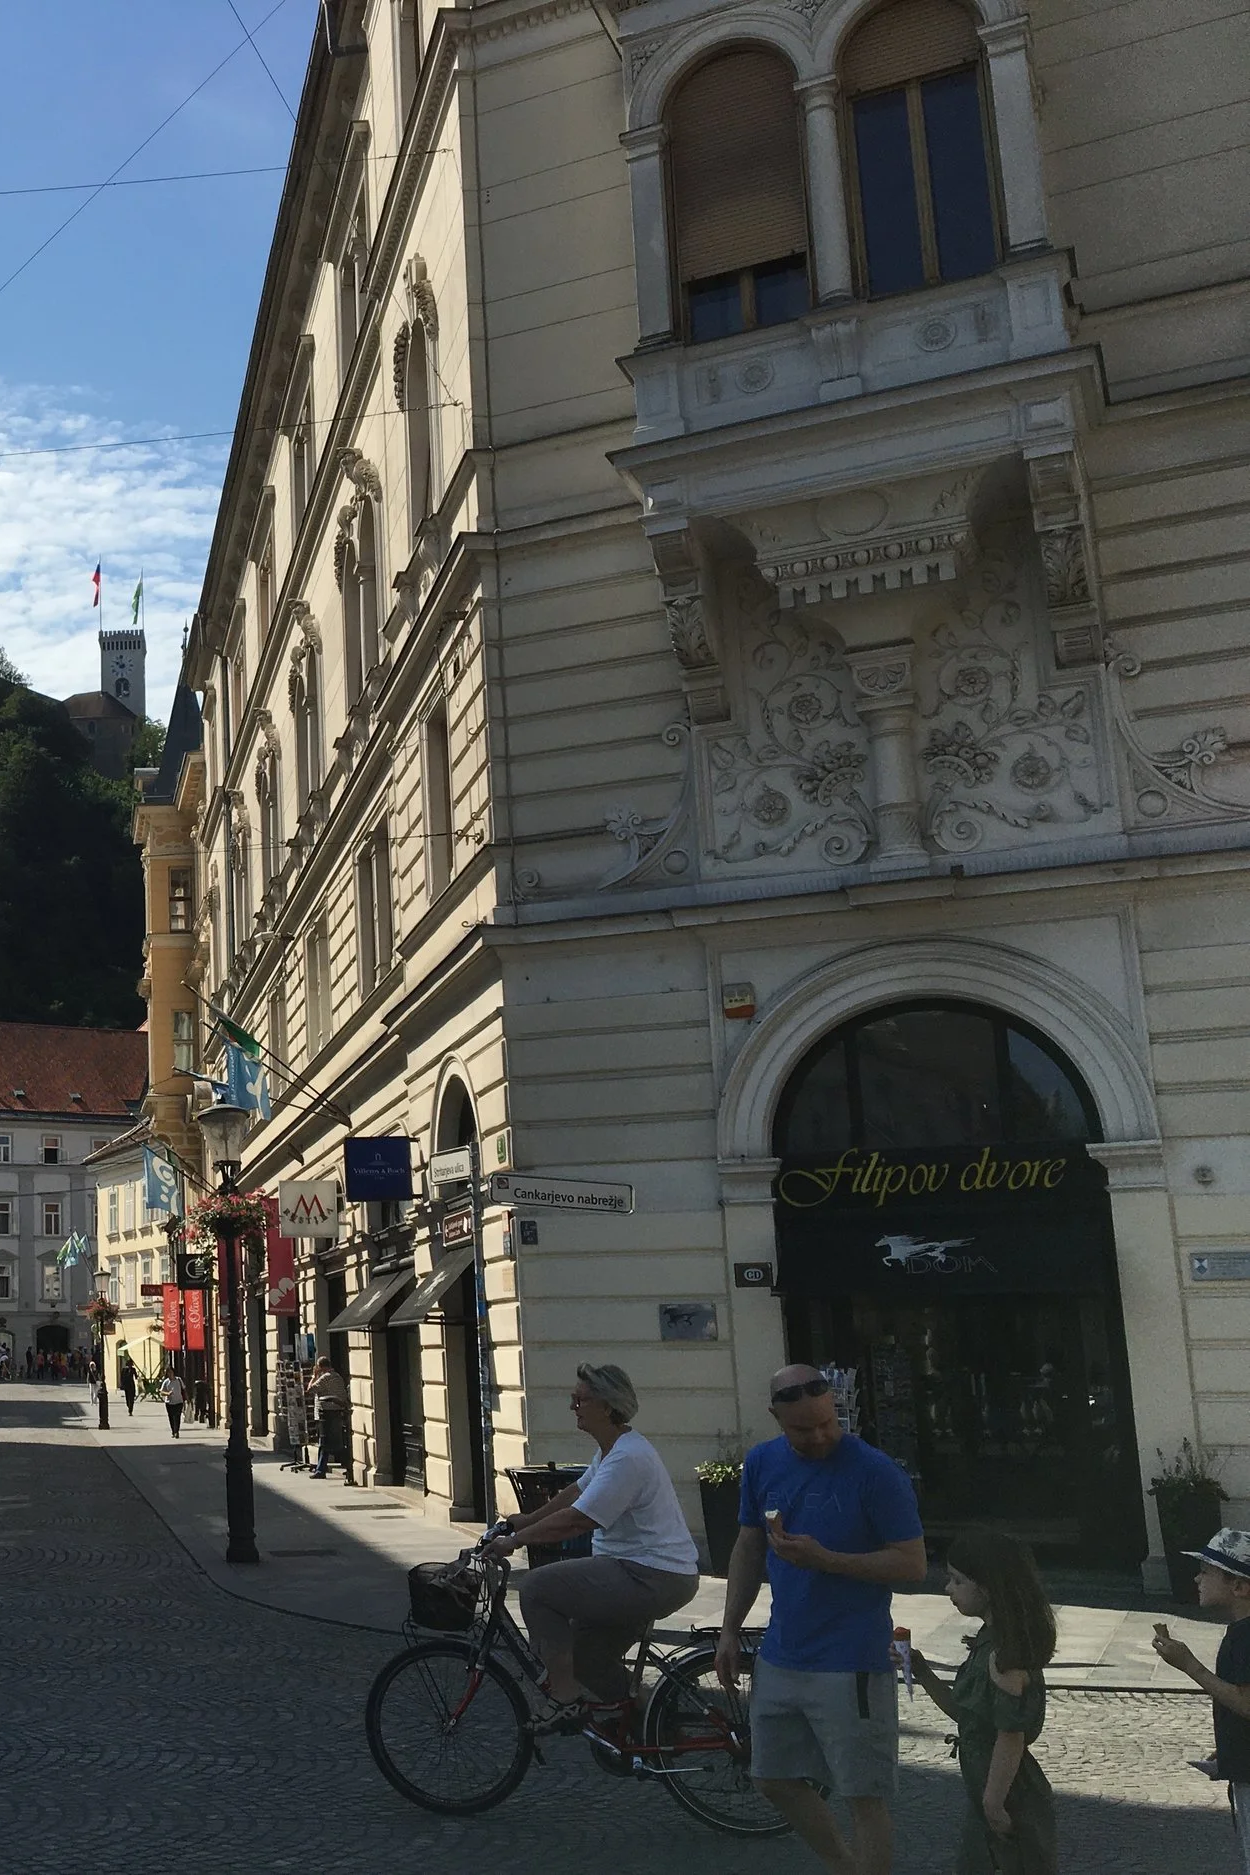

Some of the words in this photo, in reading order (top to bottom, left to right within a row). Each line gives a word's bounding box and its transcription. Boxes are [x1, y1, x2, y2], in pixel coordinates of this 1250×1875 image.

[353, 1167, 379, 1175] Villeroy
[779, 1147, 949, 1208] Filipov
[959, 1145, 1067, 1192] dvore
[513, 1188, 575, 1204] Cankarjevo
[577, 1194, 624, 1209] nabrežje
[905, 1255, 999, 1274] DOM
[746, 1270, 762, 1280] CD
